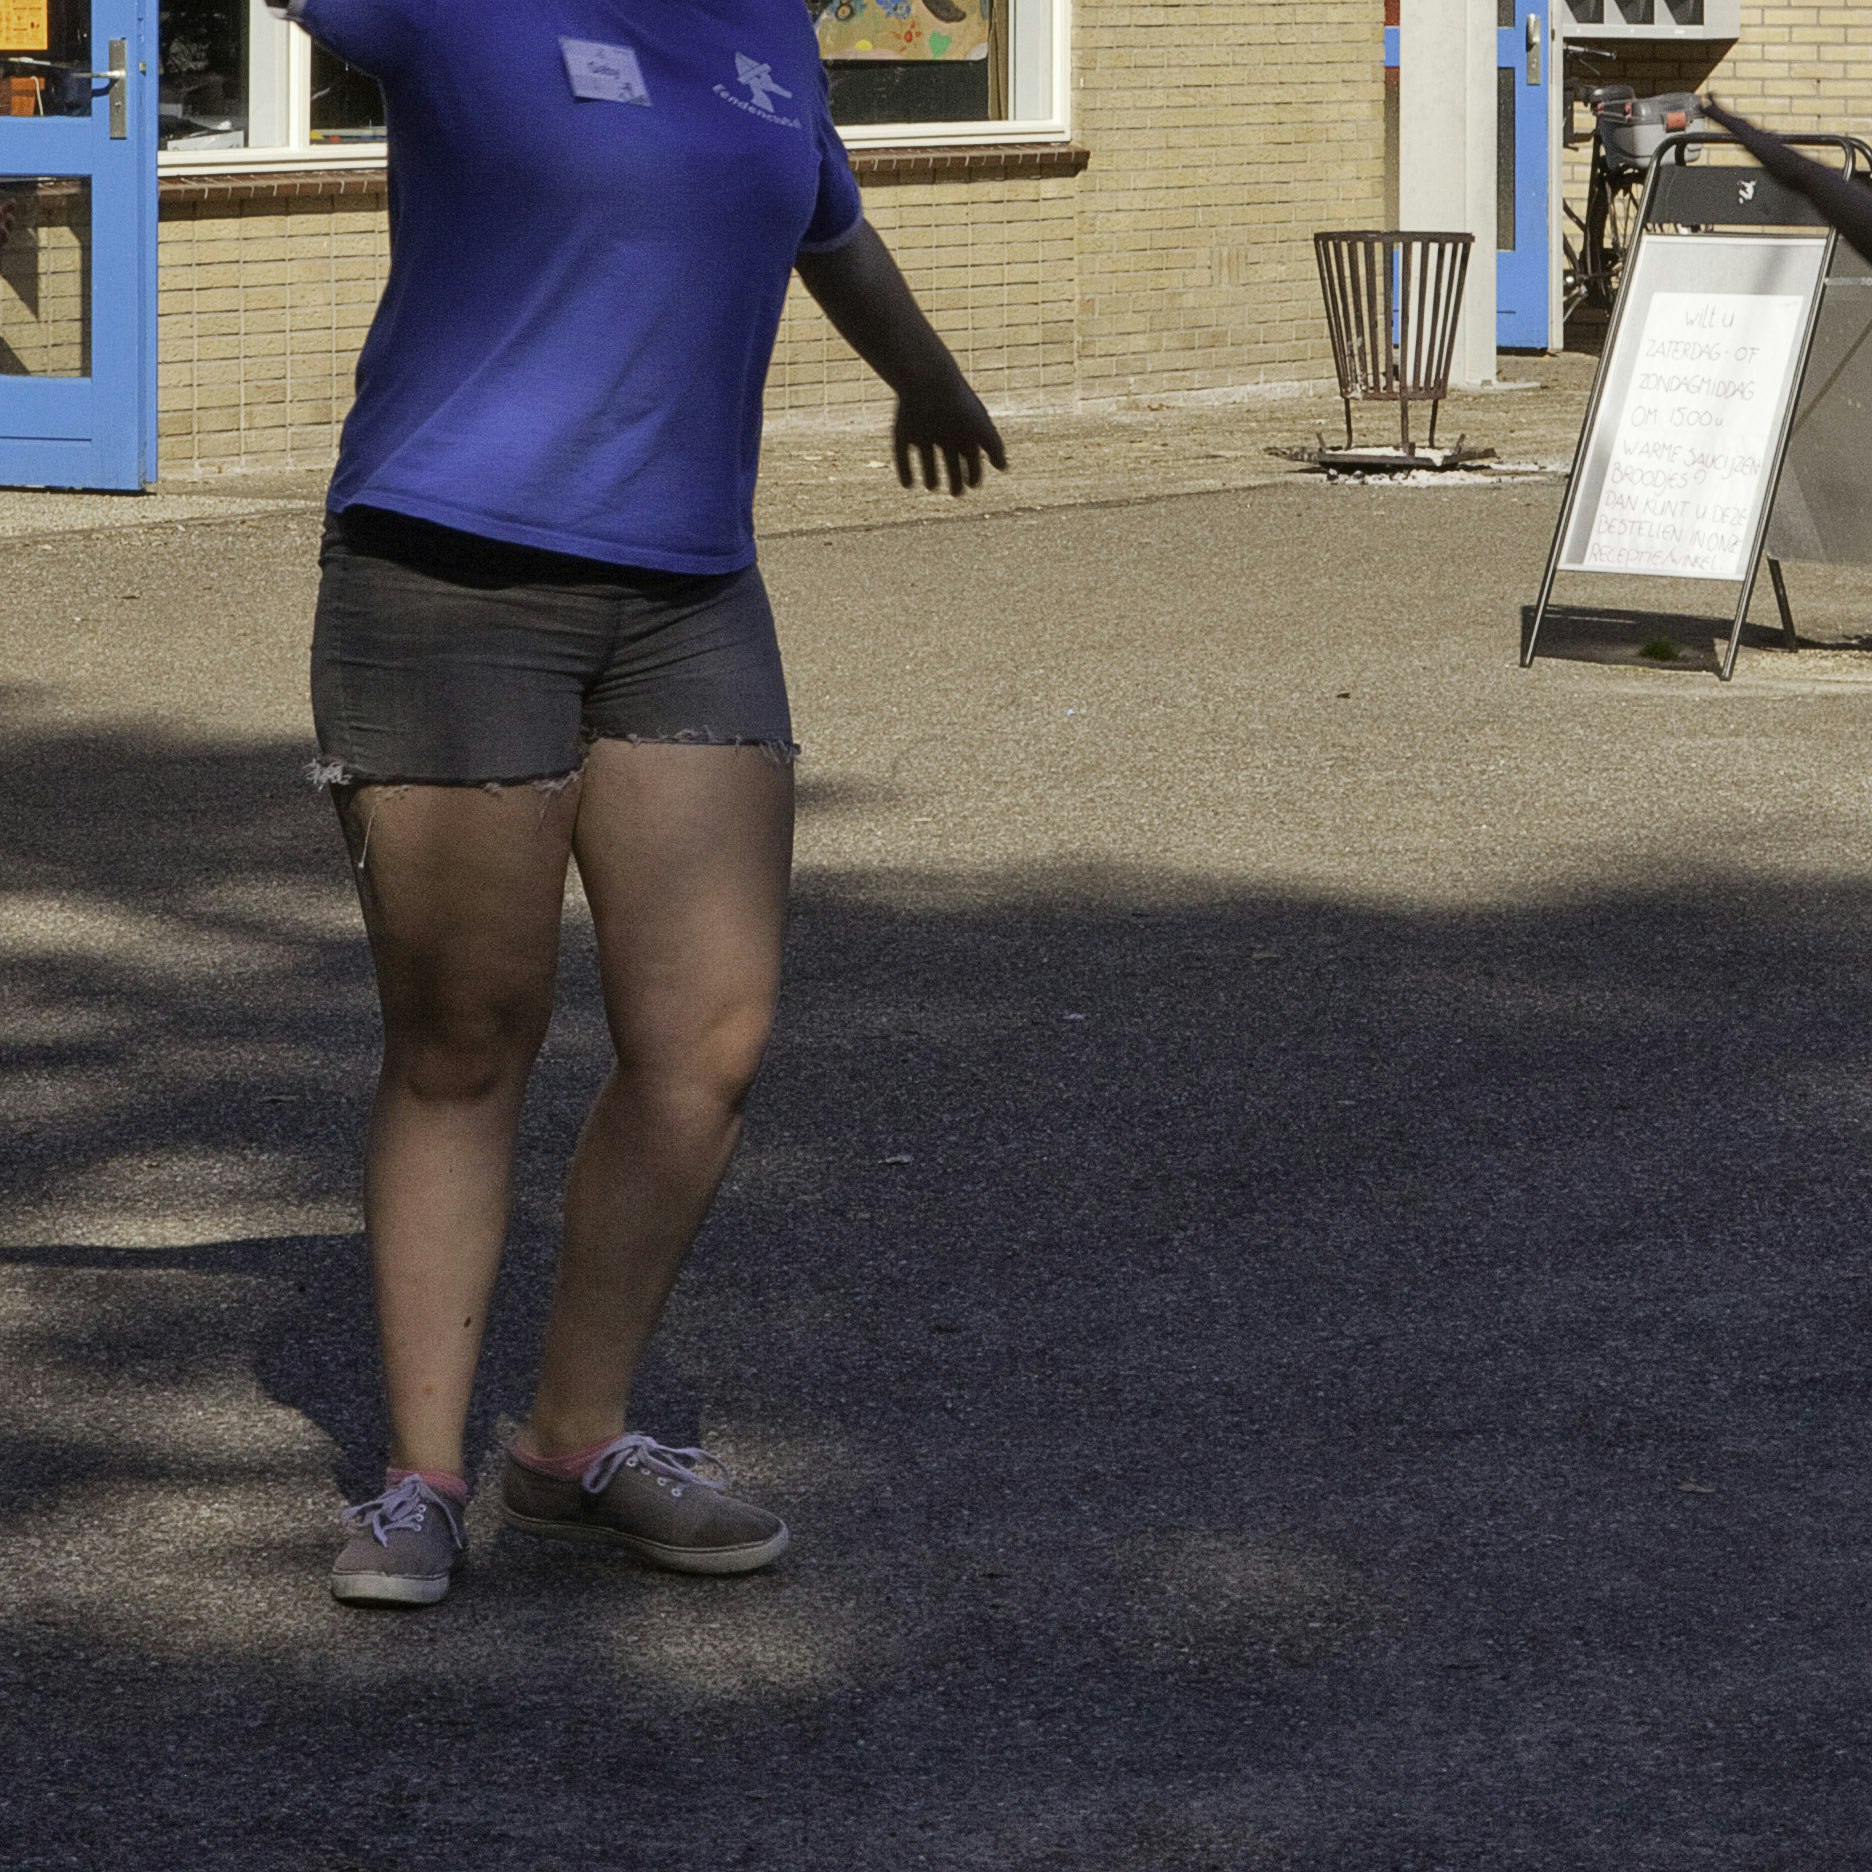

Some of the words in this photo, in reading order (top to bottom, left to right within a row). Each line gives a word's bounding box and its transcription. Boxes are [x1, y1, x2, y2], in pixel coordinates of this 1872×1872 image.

[1734, 346, 1760, 364] OF
[1638, 373, 1756, 401] ZONDAGMIDDAG
[1631, 406, 1658, 427] OM
[1623, 439, 1683, 463] WARME
[1611, 461, 1688, 496] BROODJES
[1605, 490, 1638, 511] DAN
[1643, 500, 1690, 518] KUNT
[1712, 506, 1749, 526] DEZE
[1597, 514, 1683, 542] BESTELLEN
